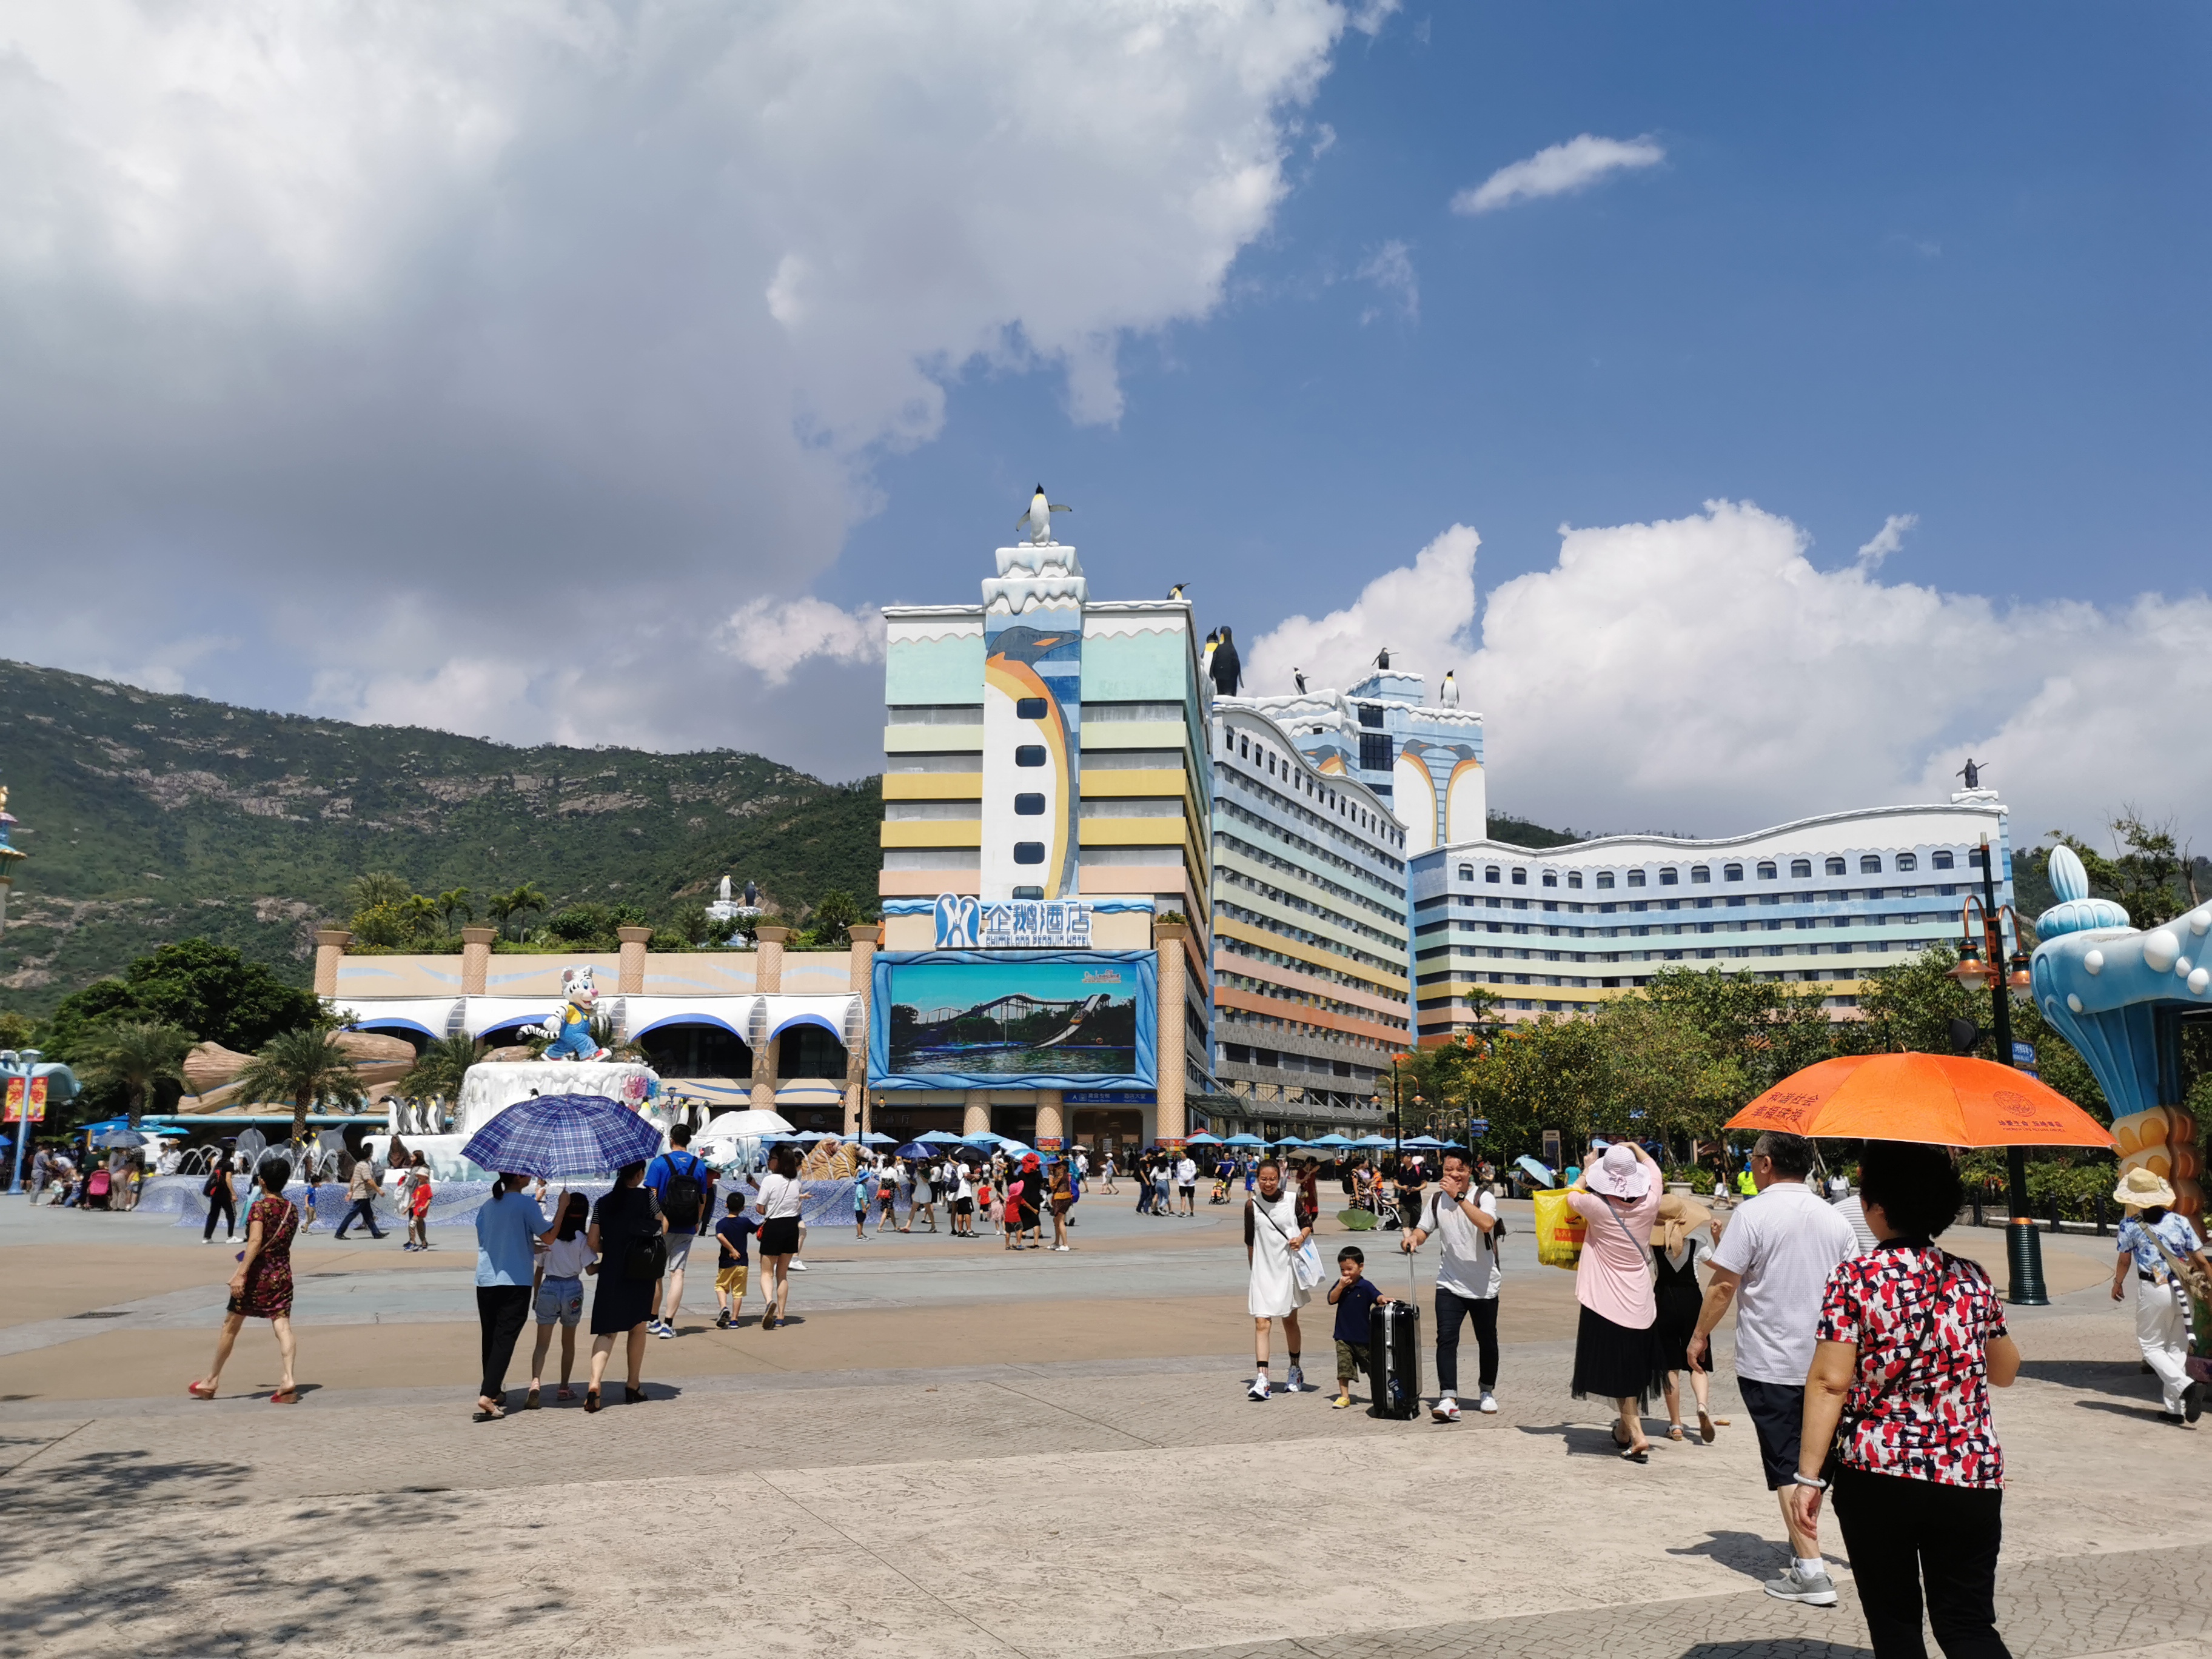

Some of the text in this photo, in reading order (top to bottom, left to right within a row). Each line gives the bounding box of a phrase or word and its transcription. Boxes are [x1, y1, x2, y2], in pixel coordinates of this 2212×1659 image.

[987, 903, 1090, 934] 企鹅酒店
[1766, 1091, 1819, 1107] 和谐社会
